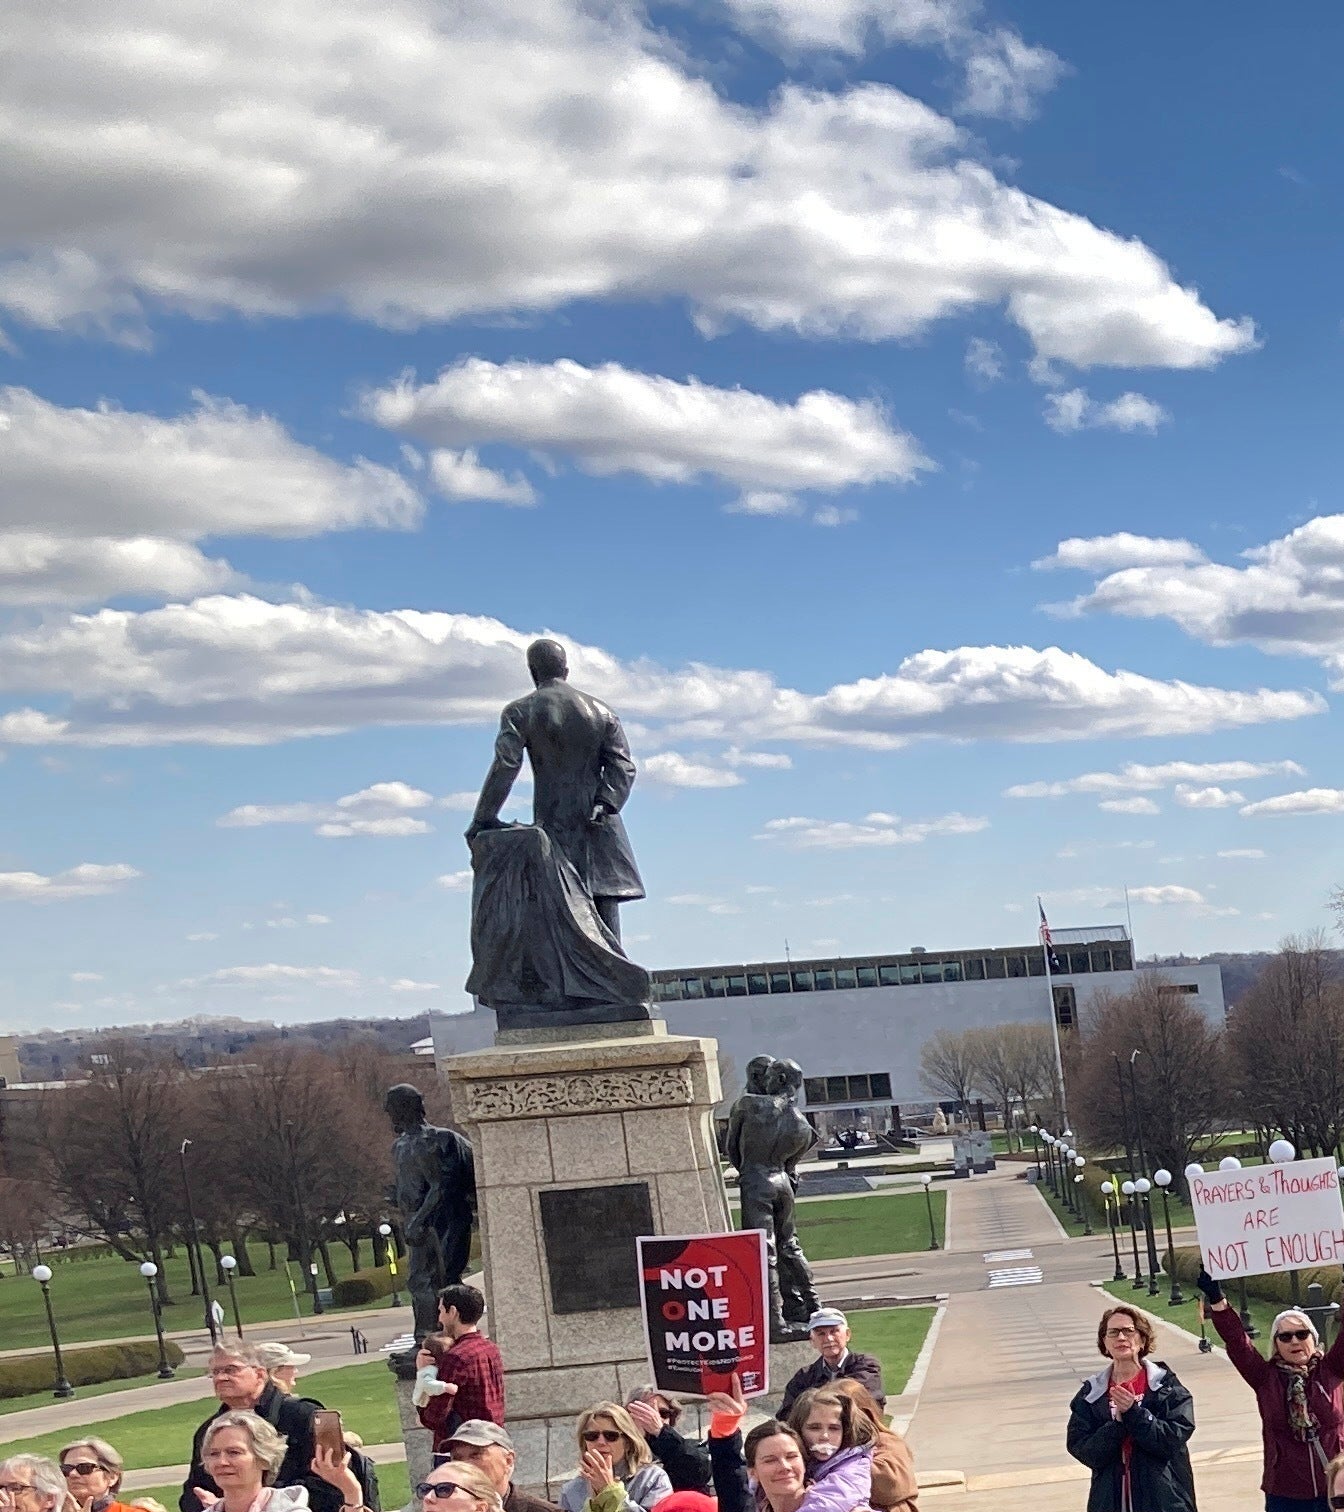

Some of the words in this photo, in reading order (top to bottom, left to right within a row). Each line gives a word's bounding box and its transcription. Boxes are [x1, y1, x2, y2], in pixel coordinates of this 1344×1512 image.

[1194, 1178, 1255, 1206] PRAYERS
[1243, 1207, 1279, 1231] ARE
[1208, 1241, 1249, 1274] NOT
[660, 1265, 728, 1290] NOT
[662, 1297, 730, 1321] ONE
[665, 1325, 756, 1352] MORE
